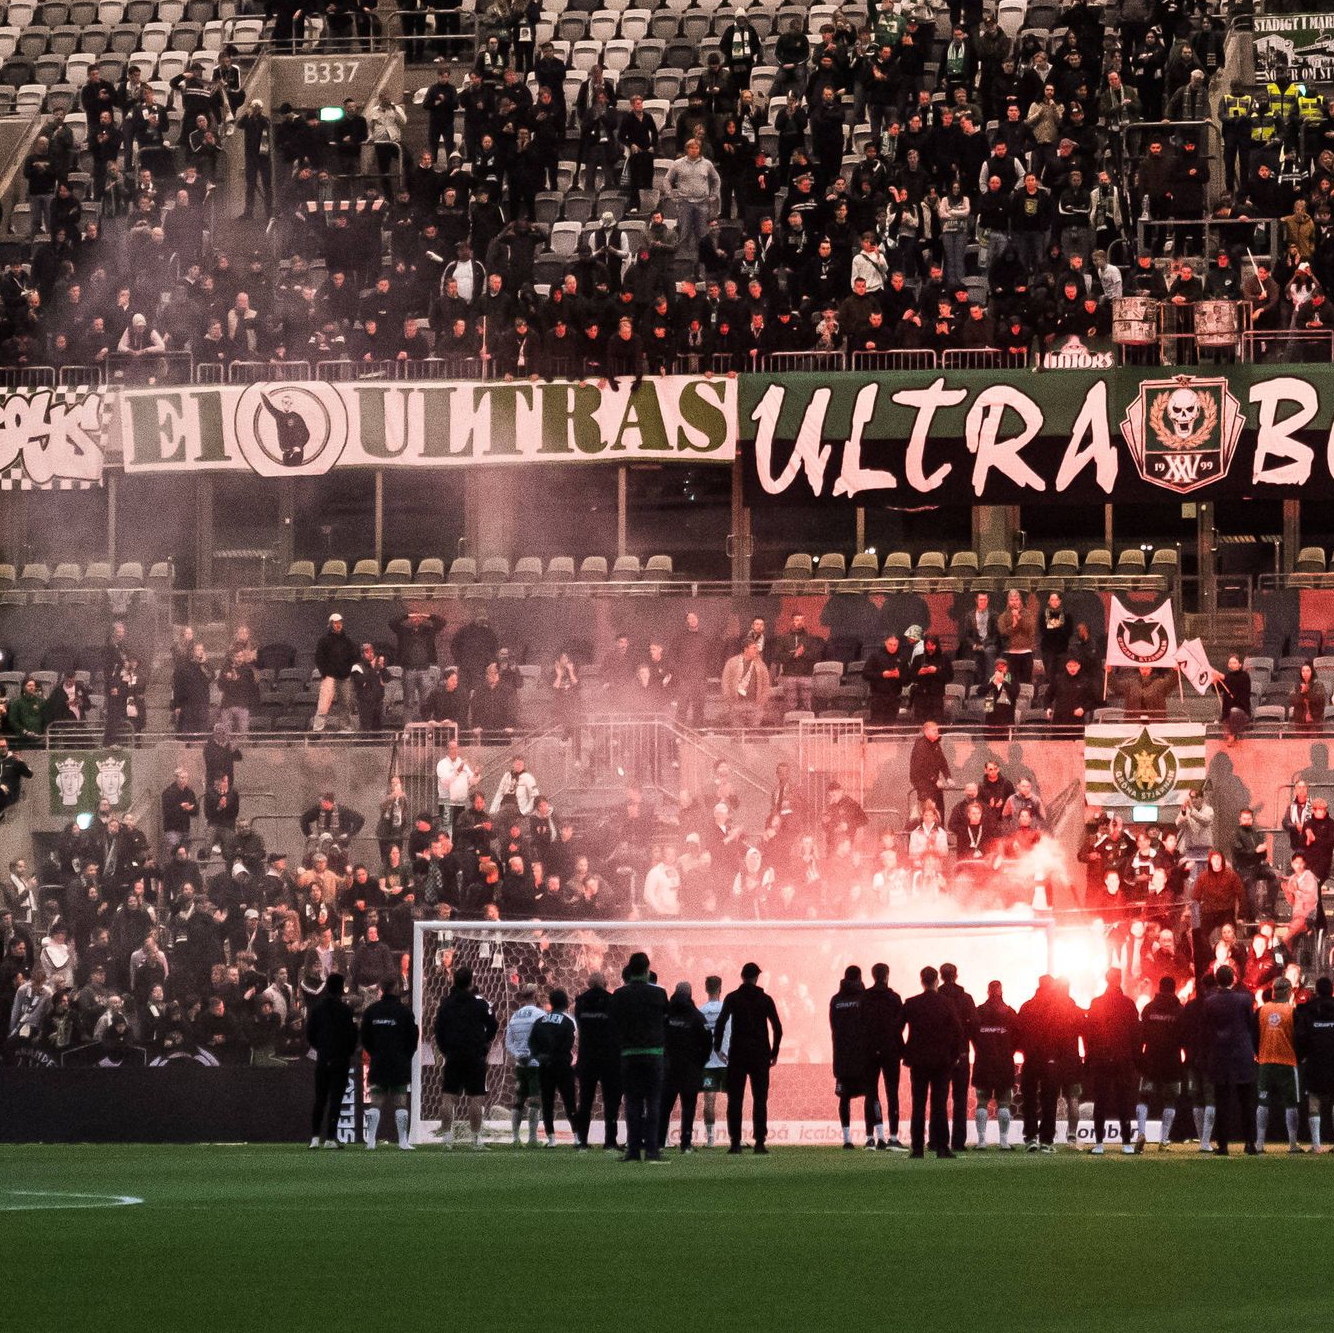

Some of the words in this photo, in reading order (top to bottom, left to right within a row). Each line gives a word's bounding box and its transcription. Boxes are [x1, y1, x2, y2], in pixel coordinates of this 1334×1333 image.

[1254, 18, 1299, 32] STADIGT
[304, 61, 360, 83] B337
[354, 379, 728, 459] ULTRAS
[751, 377, 1119, 499] ULTRA
